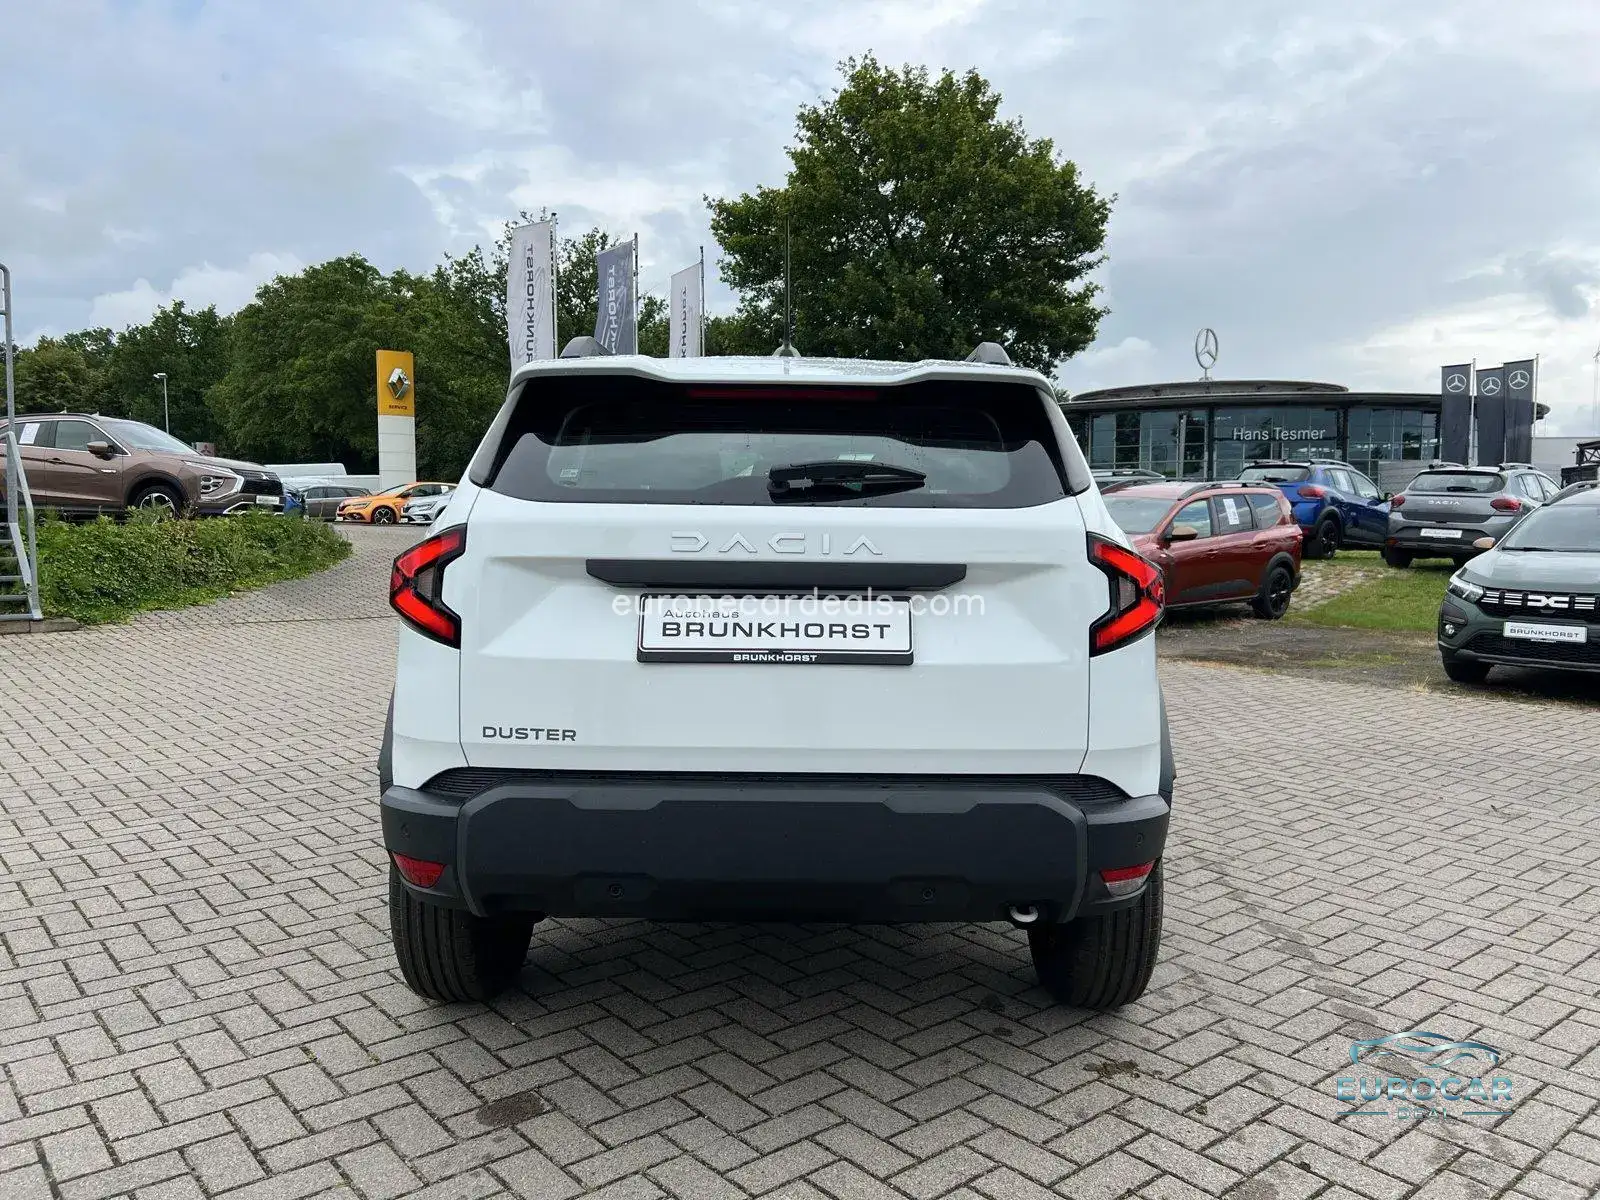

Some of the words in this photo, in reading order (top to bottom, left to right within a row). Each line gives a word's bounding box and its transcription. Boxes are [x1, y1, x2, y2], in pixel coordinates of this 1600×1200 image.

[1233, 427, 1269, 440] Hans
[1273, 427, 1326, 440] Tesmer
[671, 530, 883, 555] DACIA
[663, 608, 740, 618] Autohaus
[662, 621, 892, 640] BRUNKHORST
[1509, 628, 1580, 638] BRUNKHORST
[733, 653, 818, 662] BRUNKHORST
[482, 726, 577, 741] DUSTER
